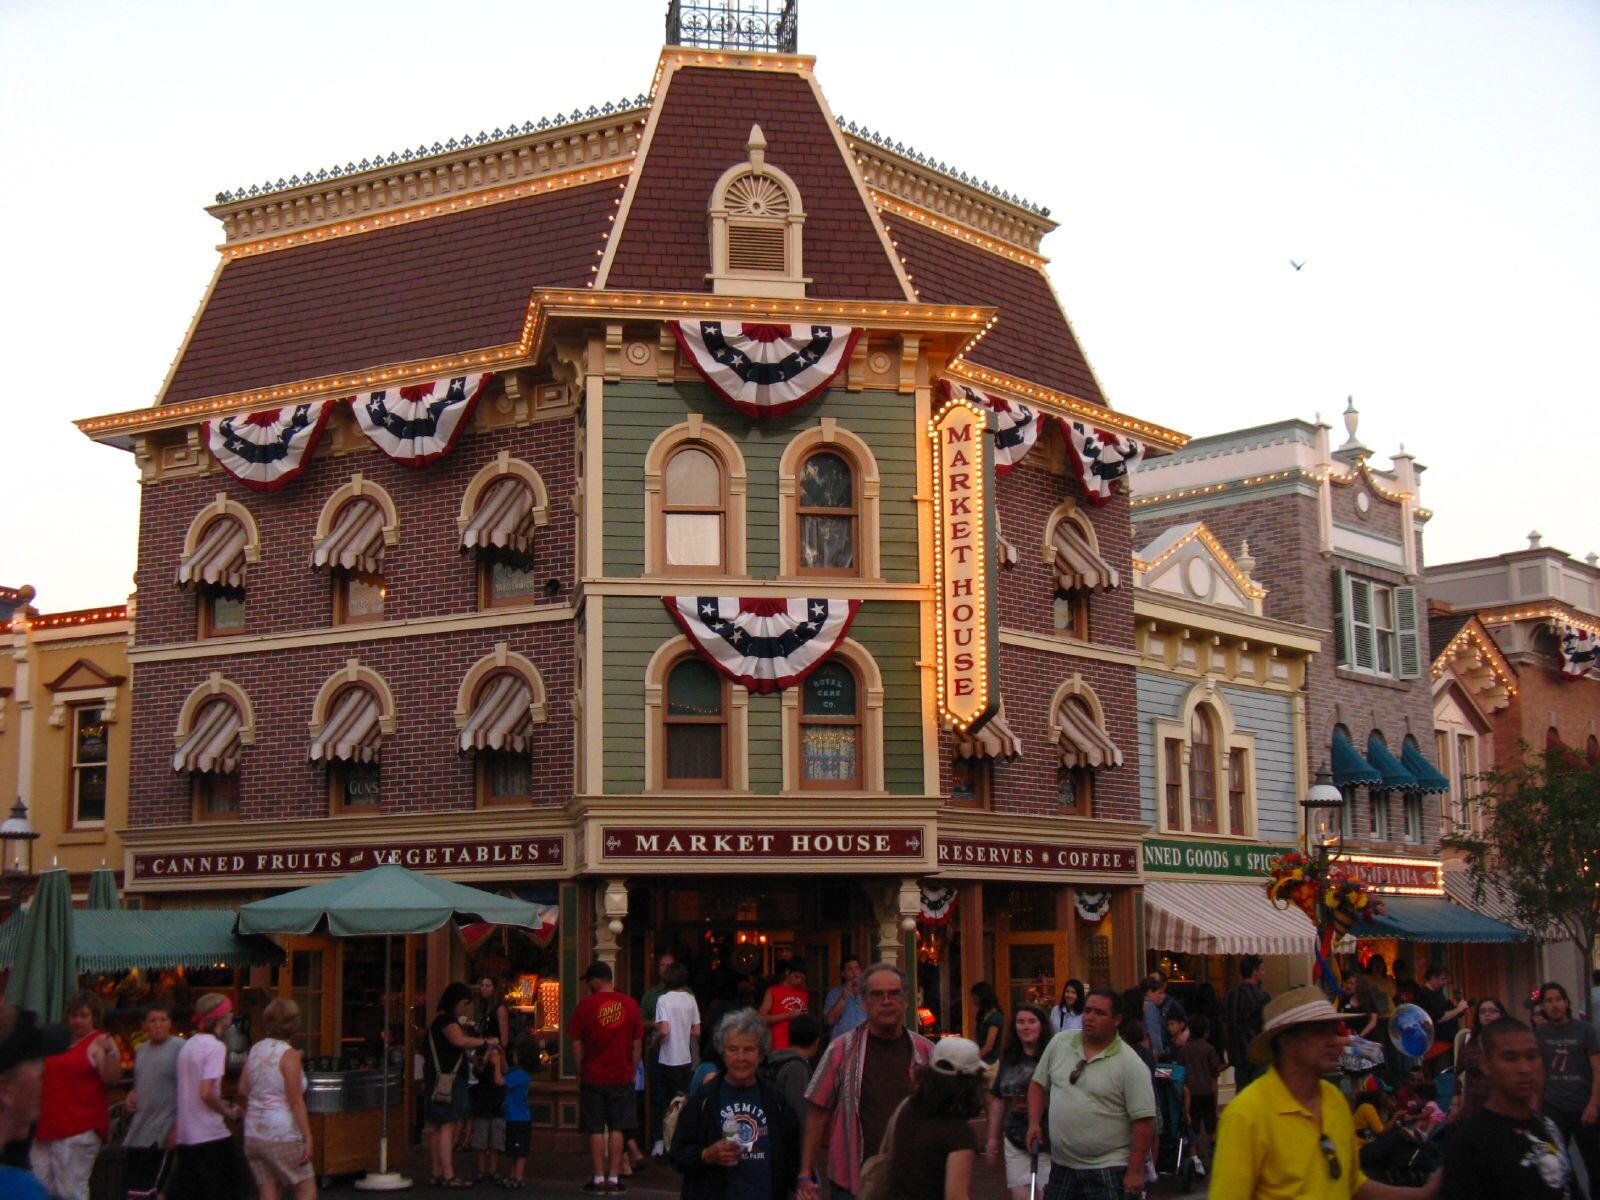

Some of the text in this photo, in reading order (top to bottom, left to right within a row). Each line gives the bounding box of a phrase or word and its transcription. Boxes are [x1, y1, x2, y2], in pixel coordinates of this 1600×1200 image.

[947, 423, 975, 697] MARKET HOUSE
[350, 780, 379, 795] GUNS
[635, 835, 891, 852] MARKET HOUSE
[152, 844, 540, 873] CANNED FRUITS and VEGETABLES
[938, 844, 1122, 868] RESERVES COFFEE
[1144, 846, 1281, 871] NNED GOODS SPIC
[597, 1001, 622, 1019] SANTA
[602, 1010, 622, 1027] CRUZ
